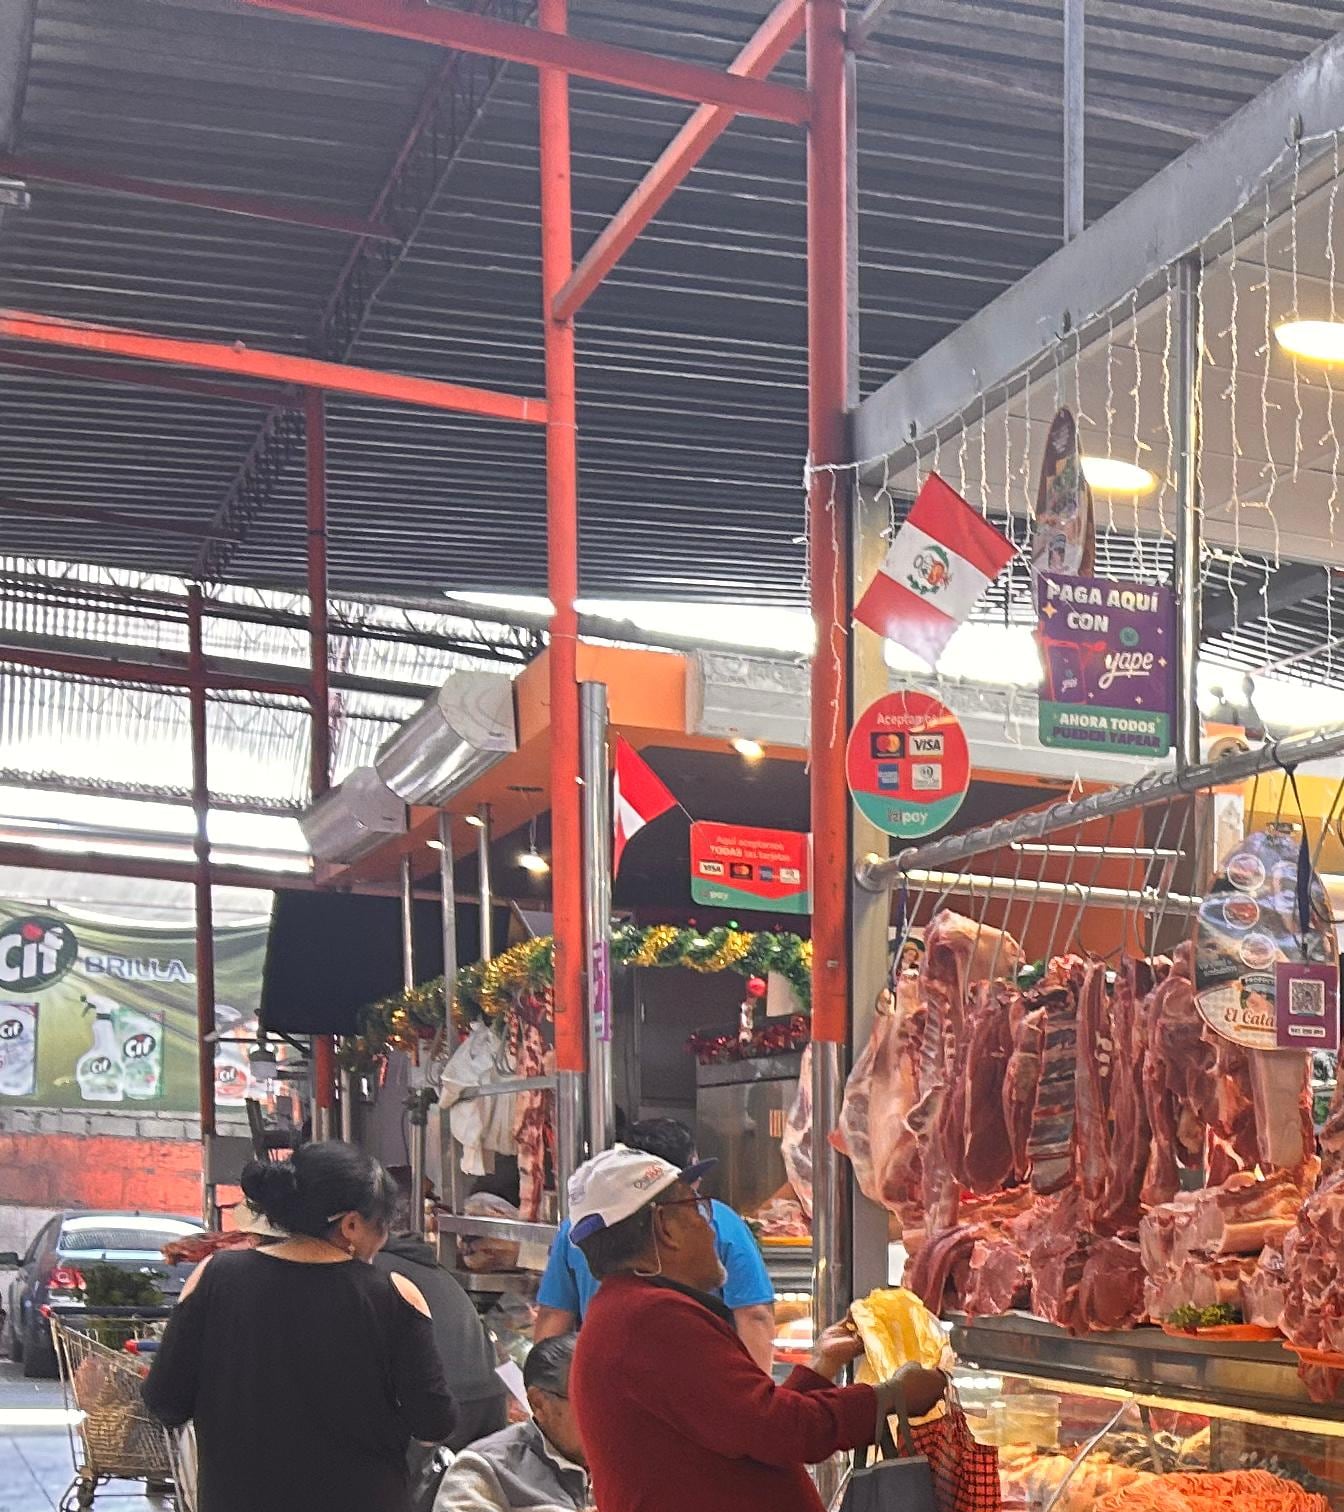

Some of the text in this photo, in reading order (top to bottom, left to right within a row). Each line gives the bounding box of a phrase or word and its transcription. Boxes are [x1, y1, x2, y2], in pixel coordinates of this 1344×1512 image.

[1047, 583, 1161, 613] PAGA AQUÍ
[1067, 611, 1110, 633] CON
[1099, 651, 1154, 689] yape
[1060, 713, 1156, 734] AHORA TODOS
[915, 739, 941, 751] VISA
[84, 954, 195, 983] BRILLA
[1224, 1007, 1275, 1028] El Cata
